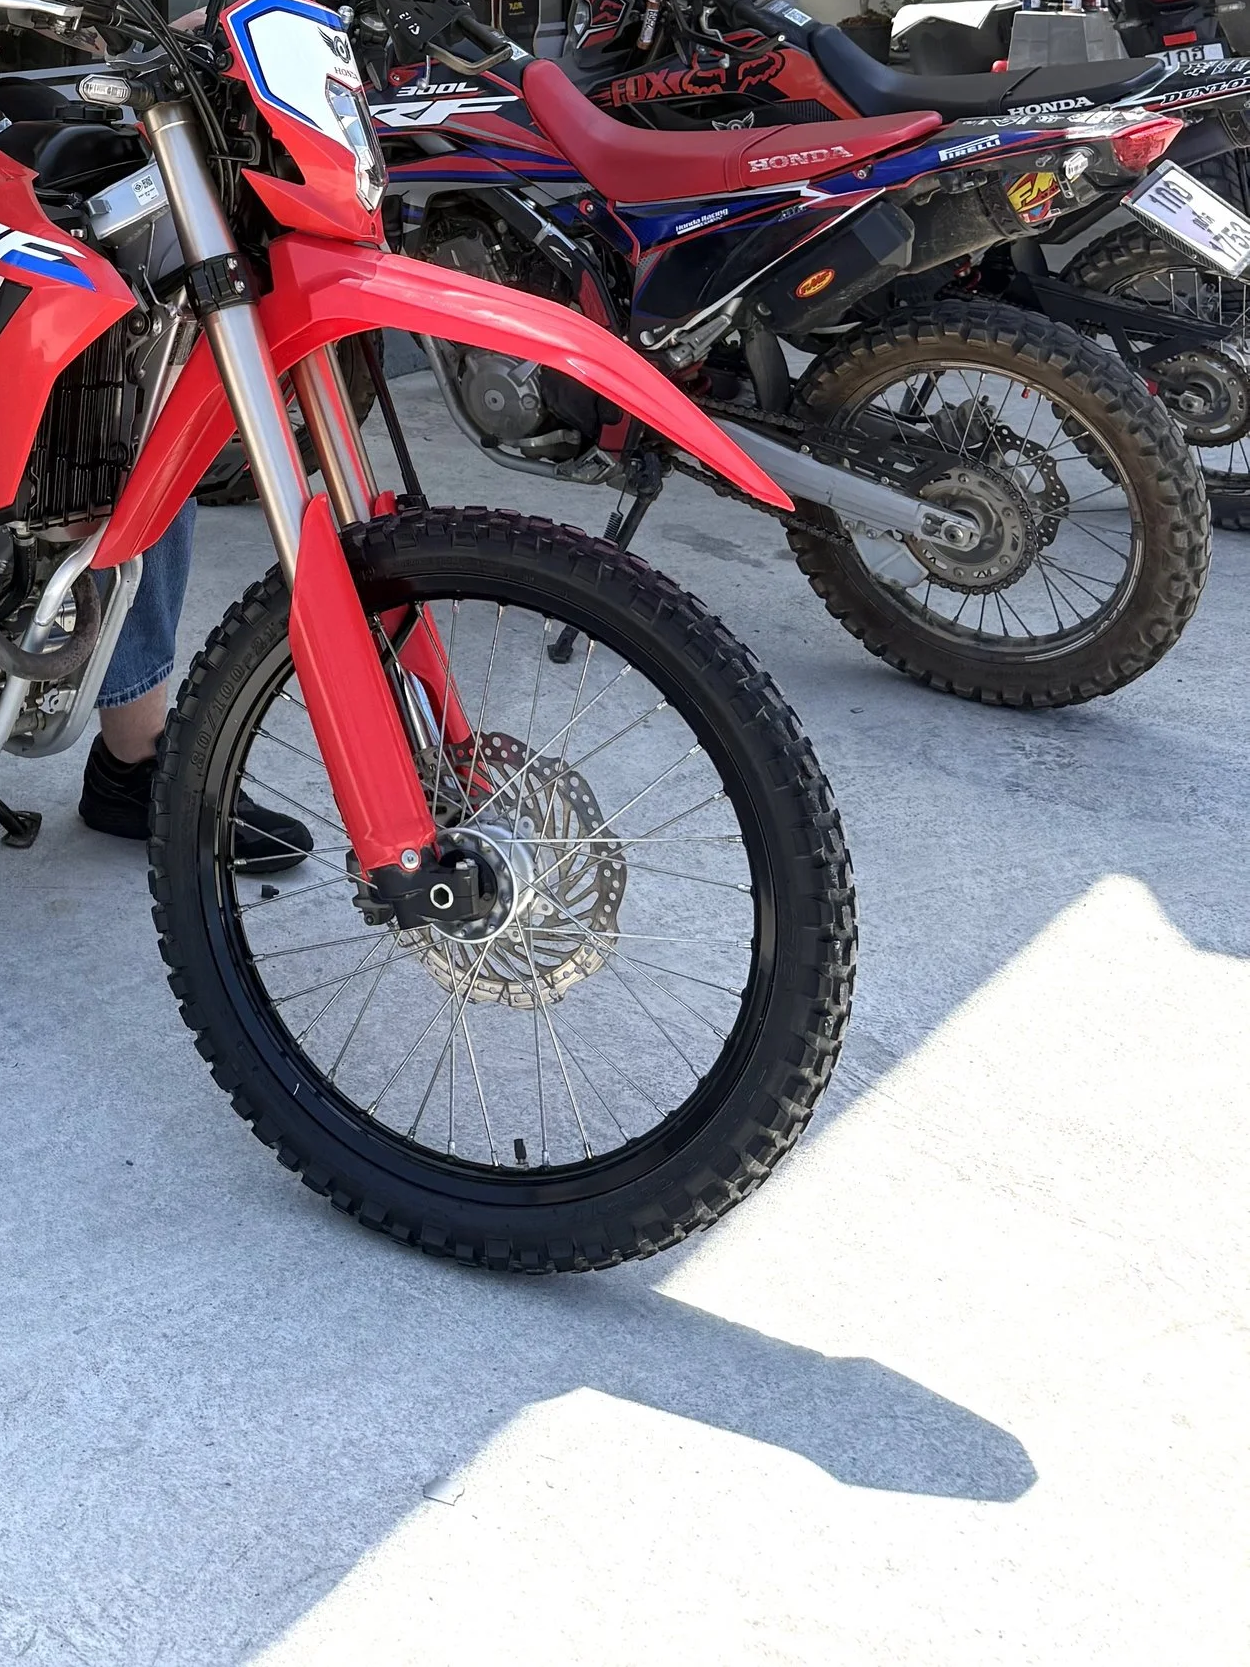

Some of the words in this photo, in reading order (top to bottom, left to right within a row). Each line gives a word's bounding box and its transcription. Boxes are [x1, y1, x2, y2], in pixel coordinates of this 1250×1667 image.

[610, 69, 672, 108] FOX
[1161, 76, 1250, 106] DUNLO
[1006, 96, 1095, 116] HONDA
[747, 145, 854, 173] HONDA
[938, 134, 1001, 162] PIRELLI
